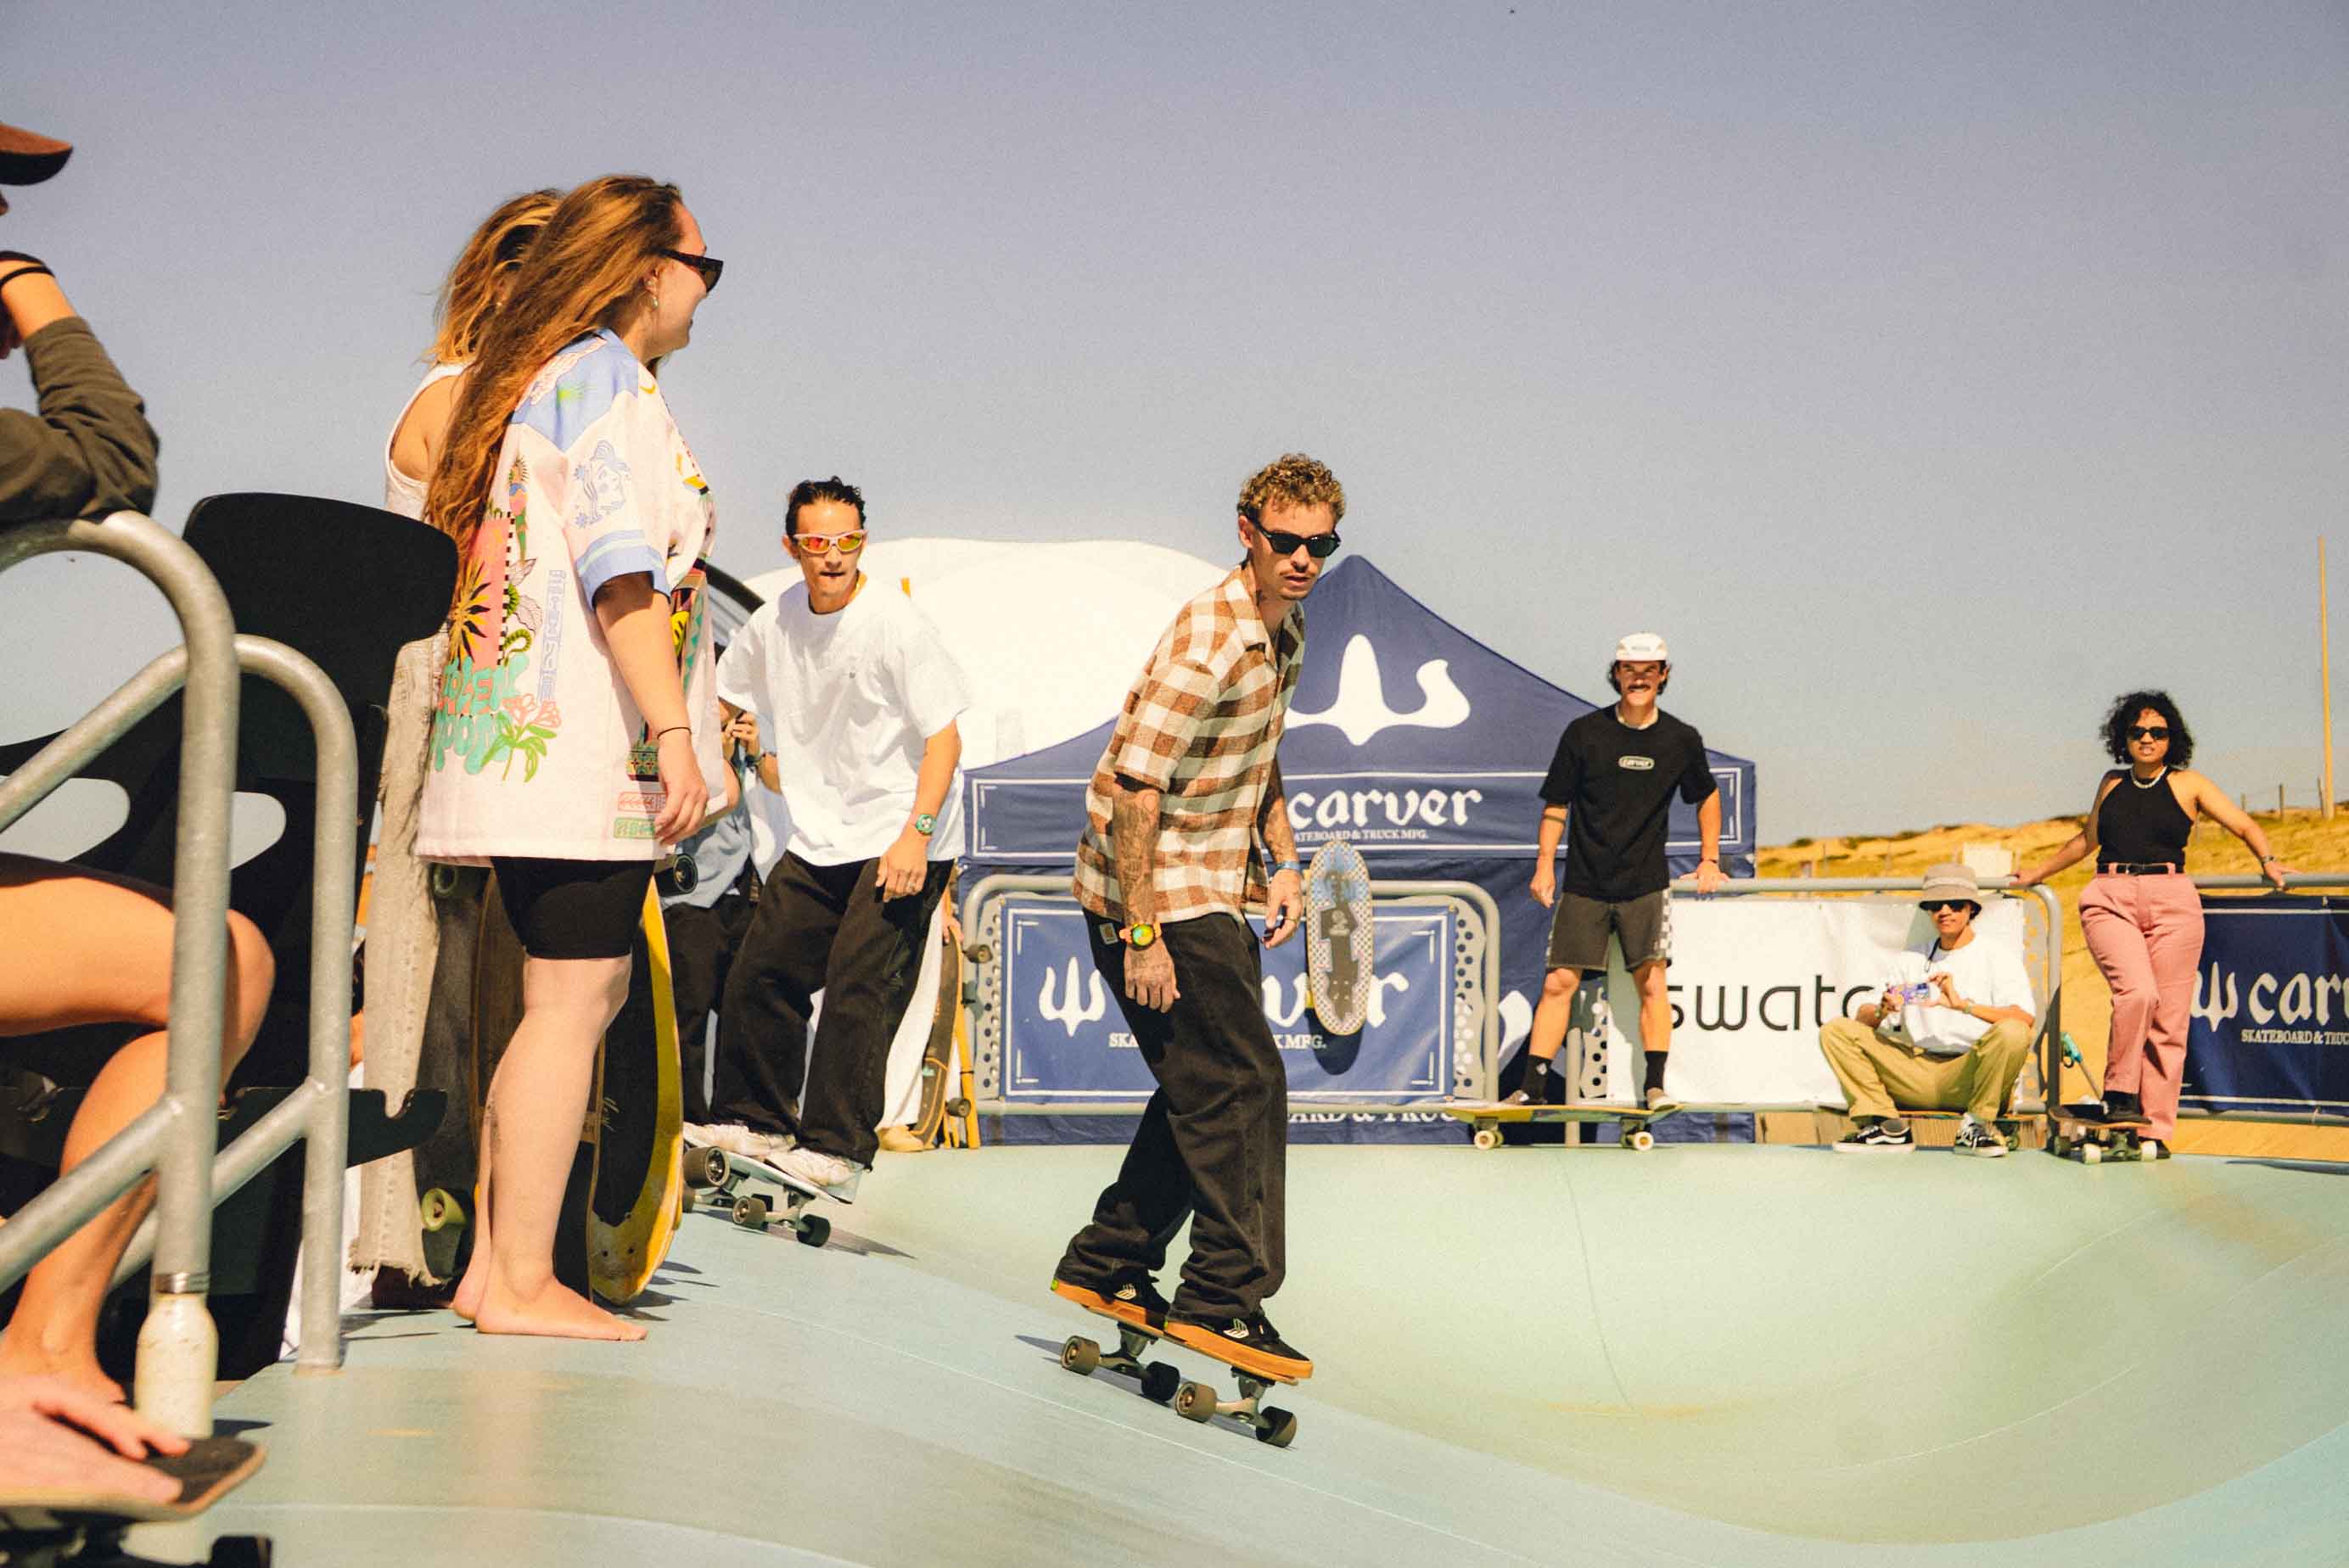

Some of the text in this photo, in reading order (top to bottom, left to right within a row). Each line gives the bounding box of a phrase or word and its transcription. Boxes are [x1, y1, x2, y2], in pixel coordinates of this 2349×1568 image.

[1287, 789, 1483, 829] carver
[1294, 830, 1352, 842] ATEBOARD
[1353, 829, 1361, 839] &
[1362, 828, 1400, 840] TRUCK
[1668, 974, 1874, 1031] swatc
[1283, 1033, 1326, 1049] MFG.
[2241, 1028, 2313, 1044] SKATEBOARD
[2313, 1030, 2324, 1044] &
